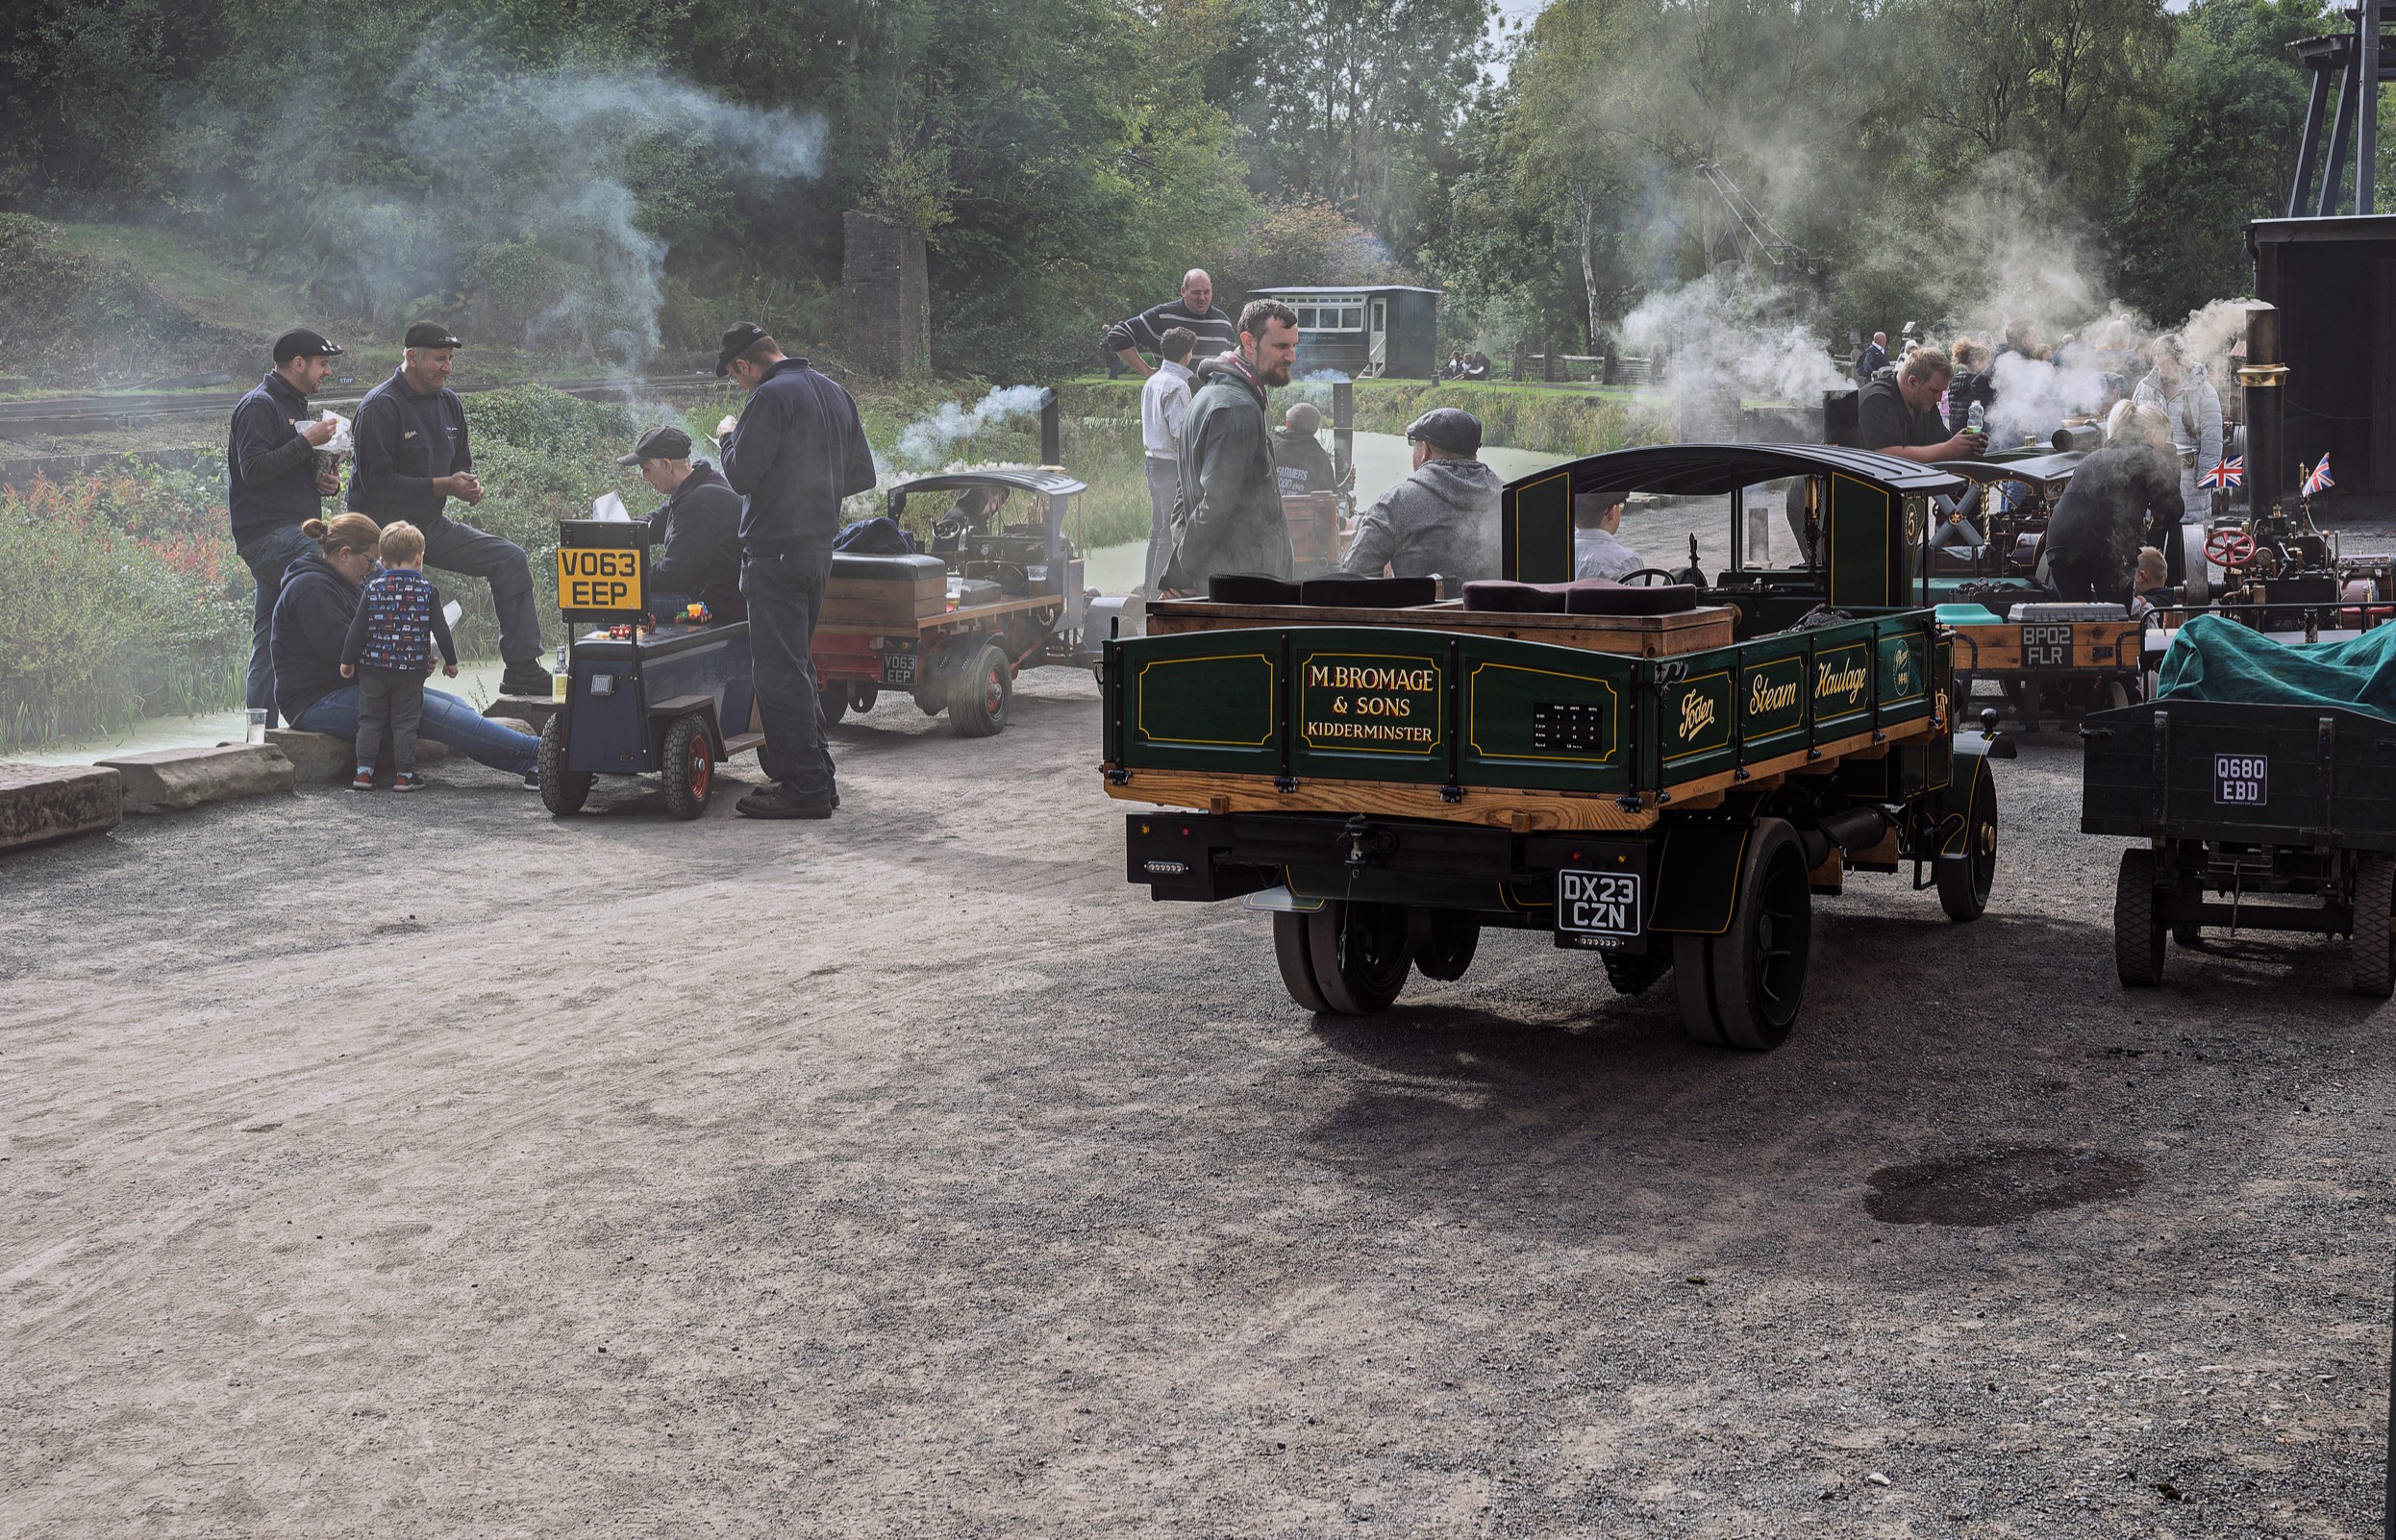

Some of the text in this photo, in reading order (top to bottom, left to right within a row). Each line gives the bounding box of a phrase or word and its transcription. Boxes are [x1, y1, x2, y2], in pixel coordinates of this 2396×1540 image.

[1277, 466, 1308, 481] FARMERS
[1277, 477, 1292, 489] OOD
[1909, 511, 1915, 536] 5
[572, 581, 627, 606] EEP
[2028, 647, 2062, 664] FLR
[887, 669, 911, 683] EEP
[1332, 696, 1410, 717] & SONS
[1679, 658, 1867, 742] Foden Steam Haulage
[1307, 722, 1433, 742] KIDDERMINSTER
[2217, 758, 2264, 779] Q680
[2223, 781, 2258, 801] EBD
[1564, 875, 1635, 904] DX23
[1573, 902, 1625, 929] CZN
